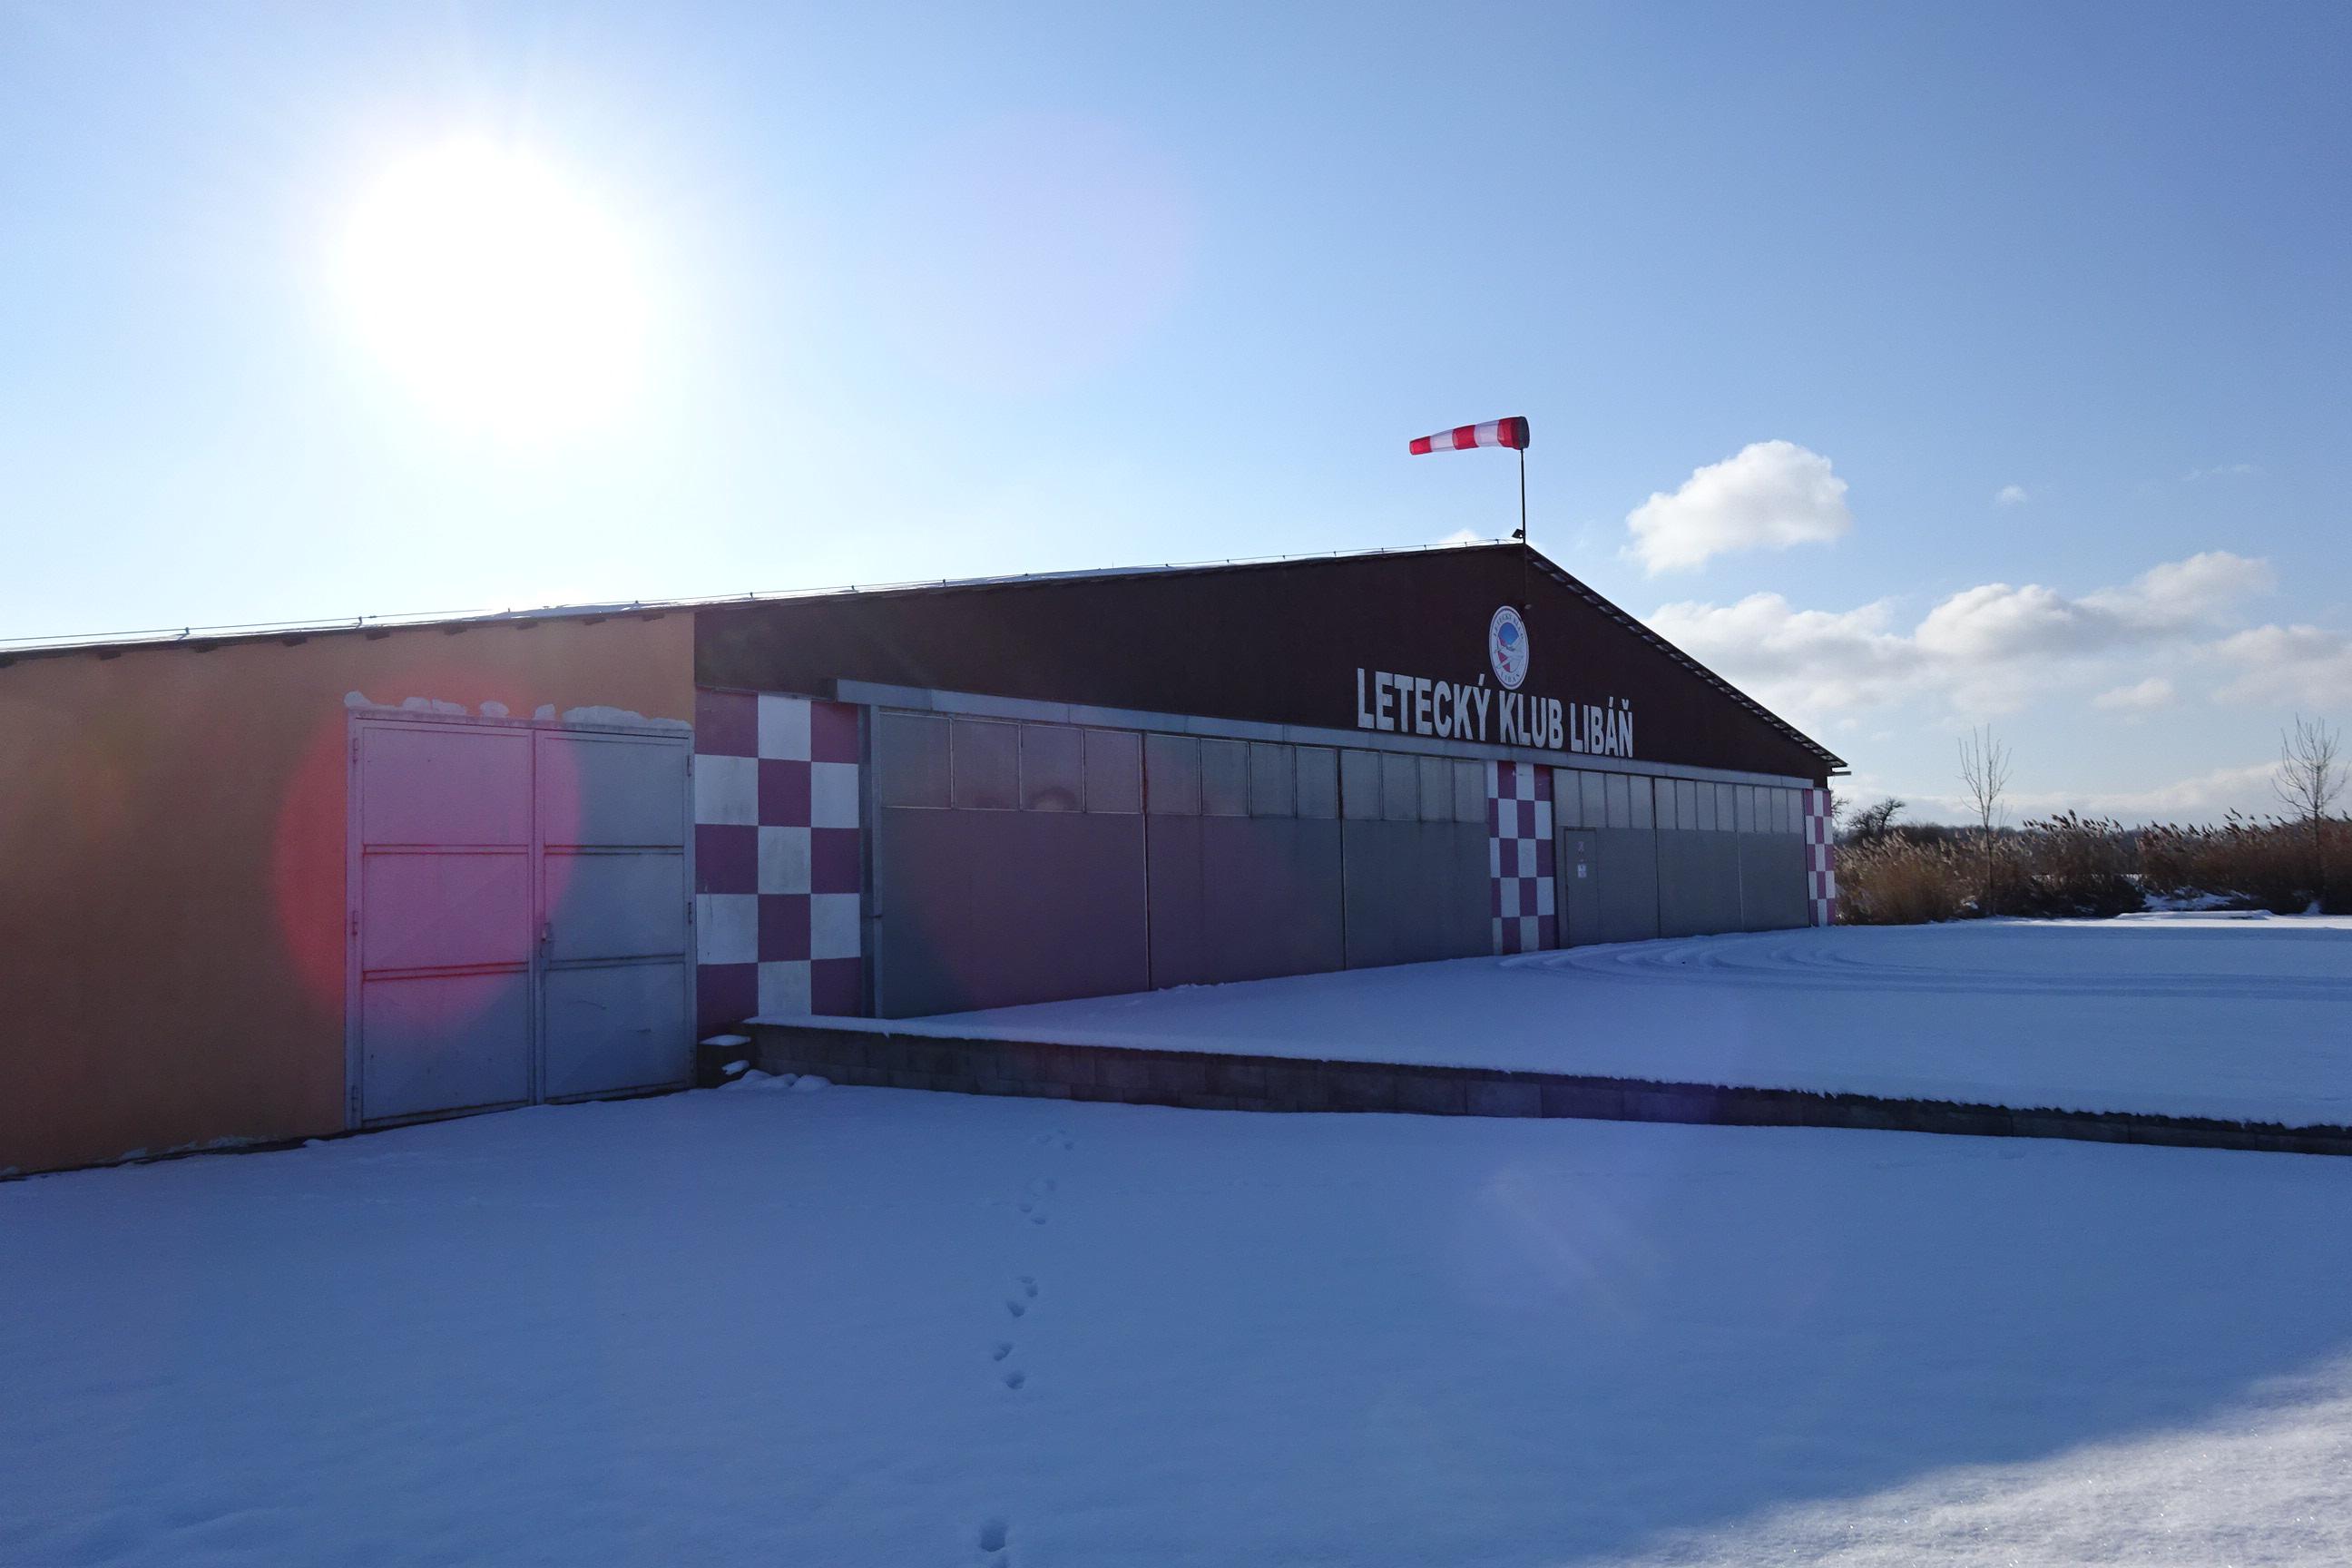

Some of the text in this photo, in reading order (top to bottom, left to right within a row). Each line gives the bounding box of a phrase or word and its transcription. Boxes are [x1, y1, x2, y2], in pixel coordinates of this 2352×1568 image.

[1357, 668, 1632, 758] LETECKÝ KLUB LIBÁŇ
